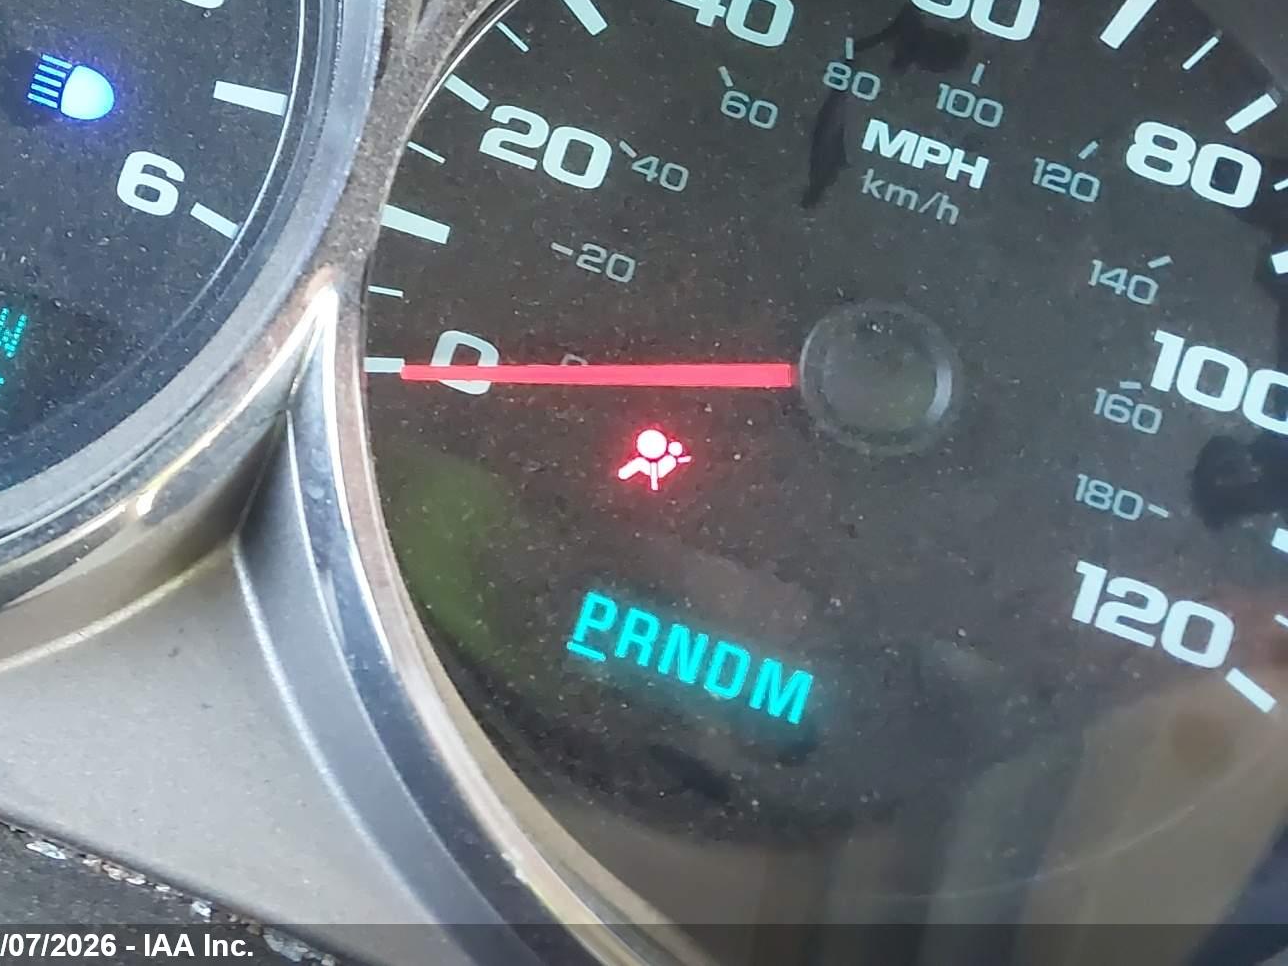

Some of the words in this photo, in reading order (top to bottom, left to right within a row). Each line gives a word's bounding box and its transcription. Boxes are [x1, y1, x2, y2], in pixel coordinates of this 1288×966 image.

[823, 62, 880, 100] 80
[721, 91, 778, 129] 60
[936, 83, 1003, 127] 100
[479, 105, 612, 189] 20
[861, 119, 989, 188] MPH
[1126, 121, 1261, 208] 80
[117, 151, 184, 216] 6
[632, 156, 688, 192] 40
[861, 169, 960, 224] km/h
[1033, 158, 1100, 202] 120
[576, 244, 635, 282] 20
[1089, 260, 1159, 305] 140
[1094, 389, 1162, 433] 160
[1076, 475, 1143, 521] 180
[1072, 561, 1235, 668] 120
